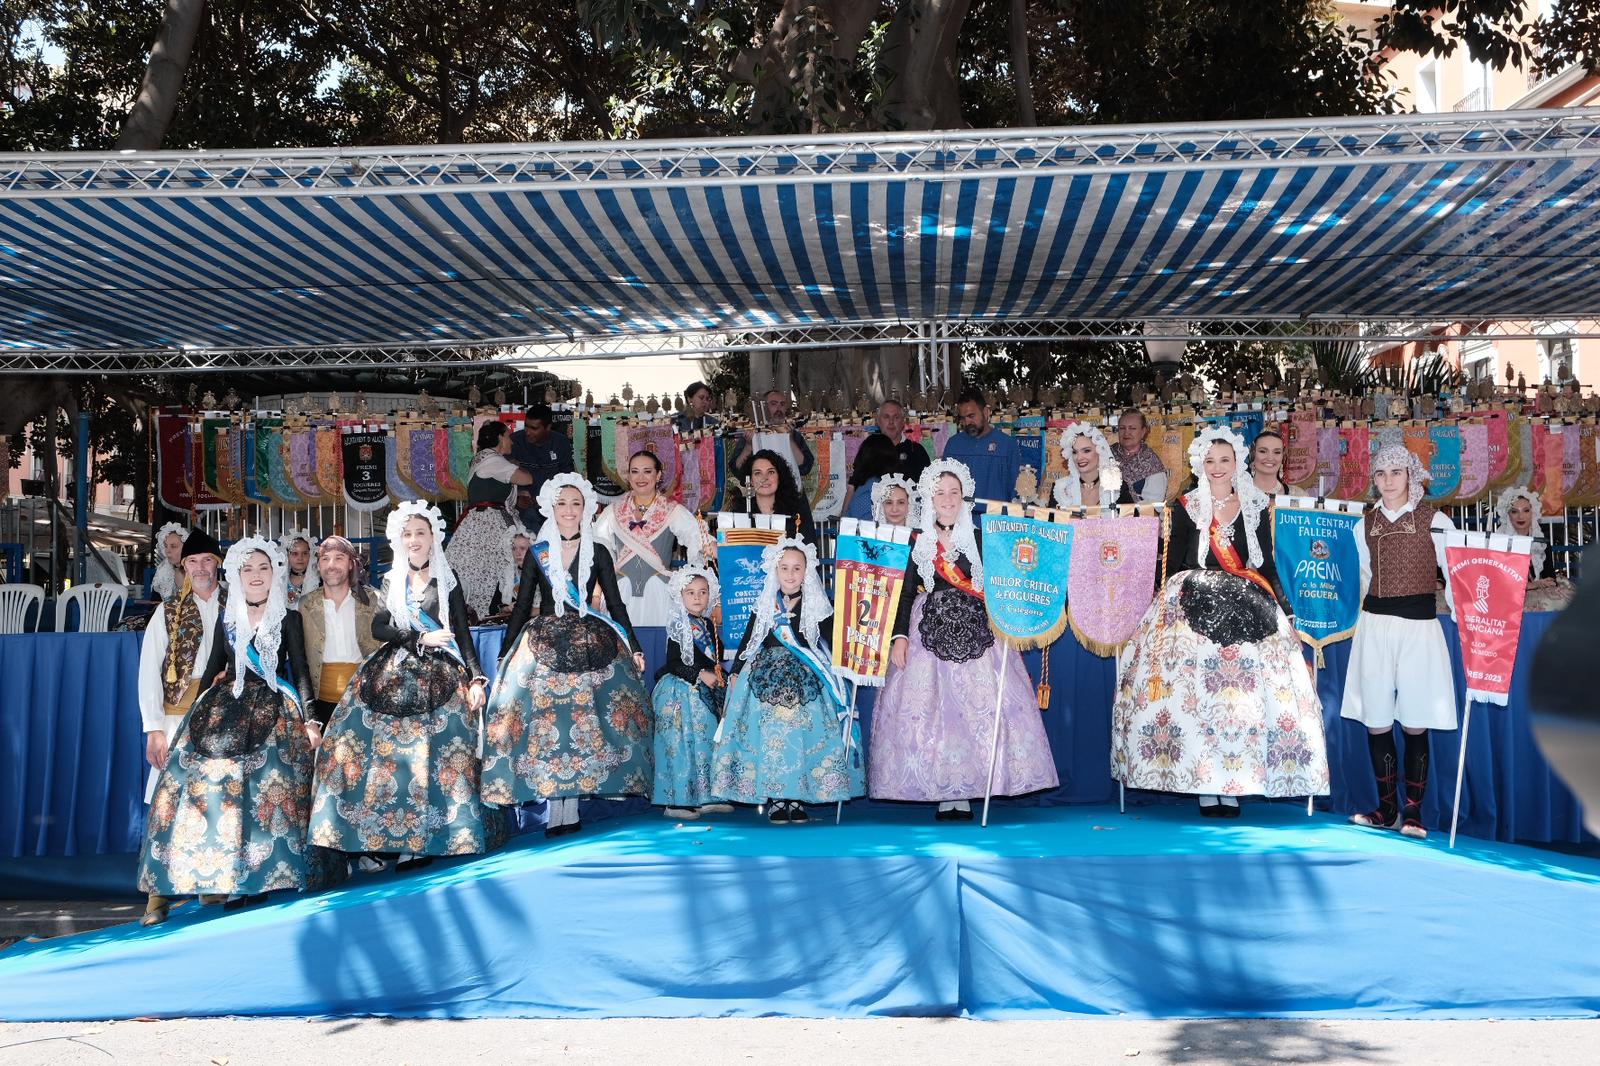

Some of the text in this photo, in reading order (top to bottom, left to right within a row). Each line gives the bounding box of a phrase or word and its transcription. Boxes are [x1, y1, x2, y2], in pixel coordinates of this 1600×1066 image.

[361, 471, 371, 481] 3
[1279, 513, 1354, 532] JUNTA CENTRAL
[1298, 526, 1338, 540] FALLERA
[1293, 560, 1342, 582] PREMI
[1471, 557, 1524, 582] GENERALITAT
[990, 575, 1021, 588] MILLOR
[1004, 590, 1051, 606] FOGUERES
[1299, 590, 1339, 601] FOGUERA
